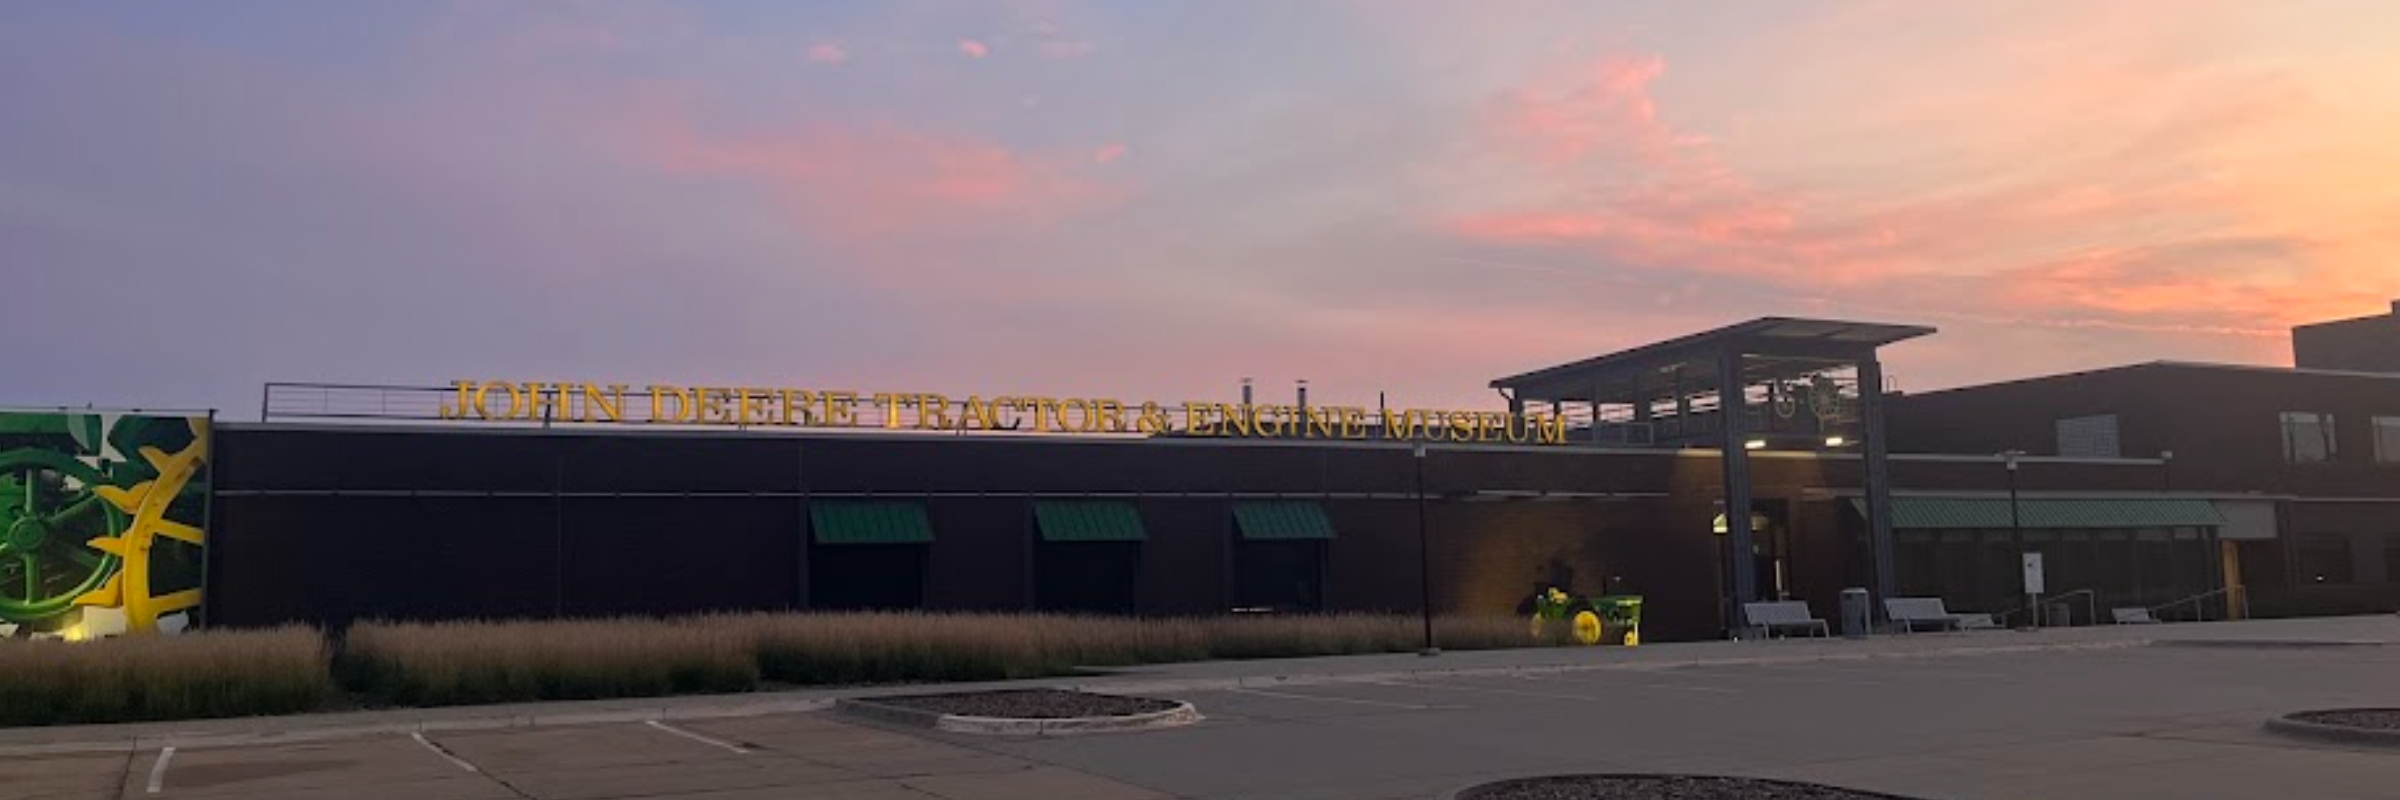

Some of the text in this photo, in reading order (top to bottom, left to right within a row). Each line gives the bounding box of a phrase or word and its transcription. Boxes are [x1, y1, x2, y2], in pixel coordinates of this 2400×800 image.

[440, 381, 1568, 445] JOHN DEERE TRACTOR & ENGINE MUSEUM
